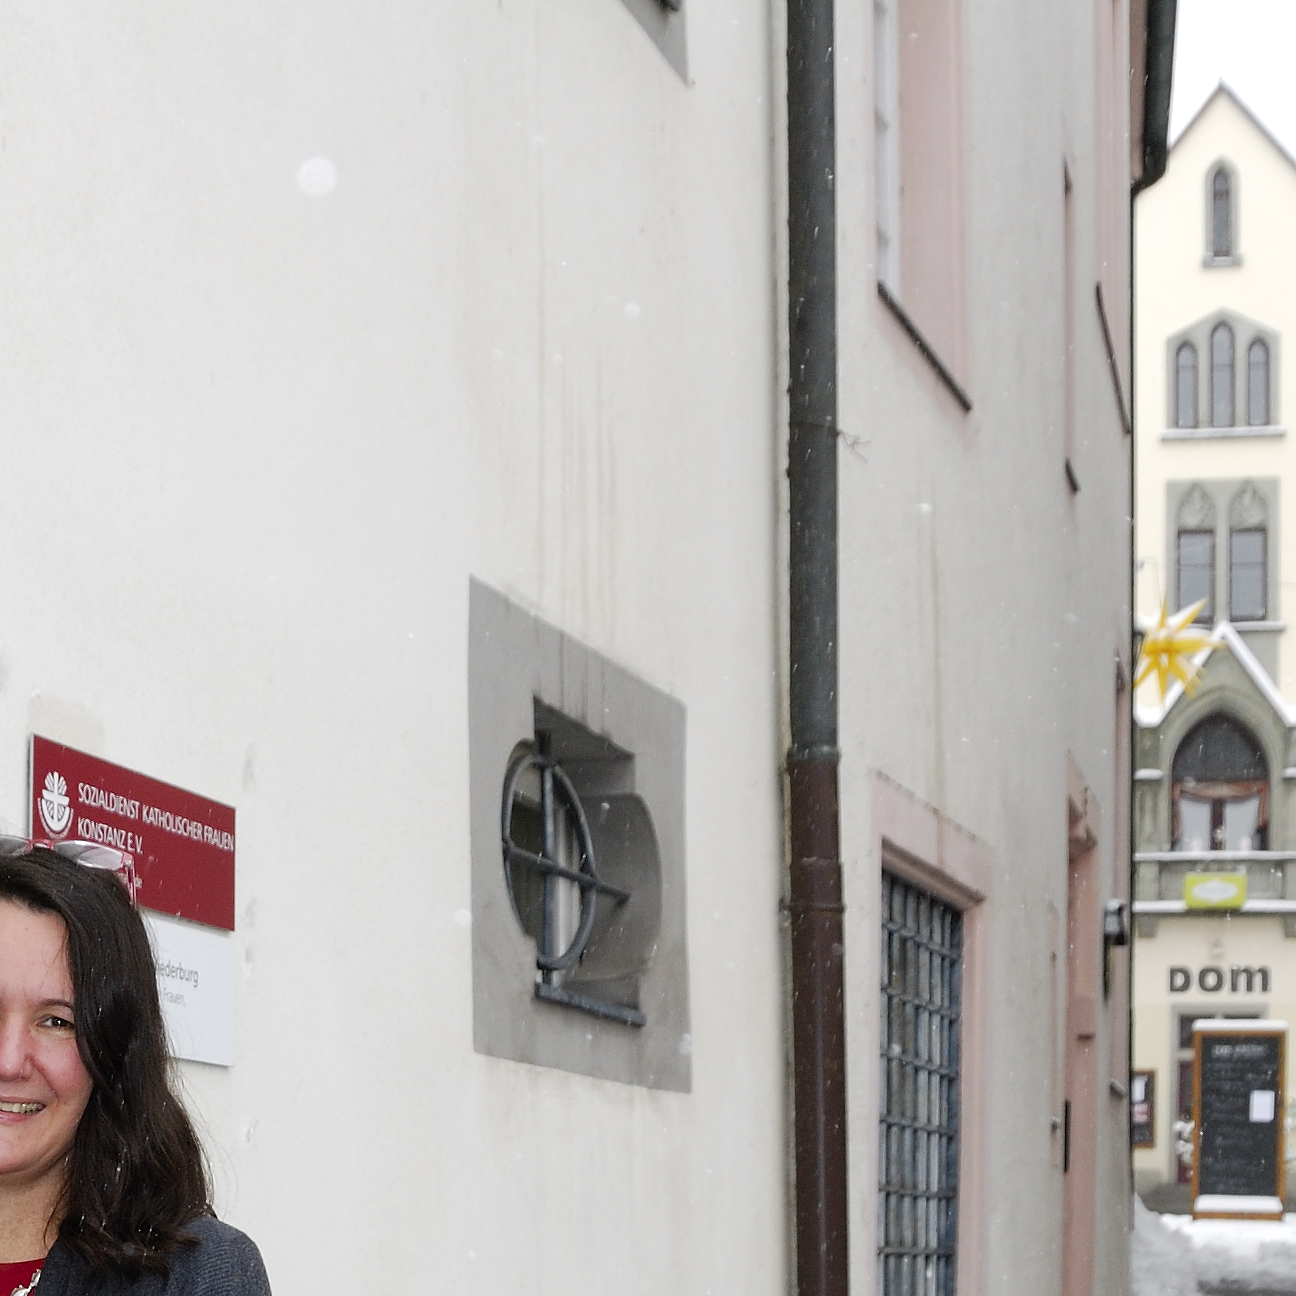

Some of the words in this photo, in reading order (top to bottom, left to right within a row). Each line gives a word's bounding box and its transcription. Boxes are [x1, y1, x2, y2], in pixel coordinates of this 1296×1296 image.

[77, 782, 140, 820] SOZIALDIENST
[142, 804, 203, 841] KATHOLISCHER
[203, 825, 234, 850] FRAUEN
[77, 817, 125, 849] KONSTANZ
